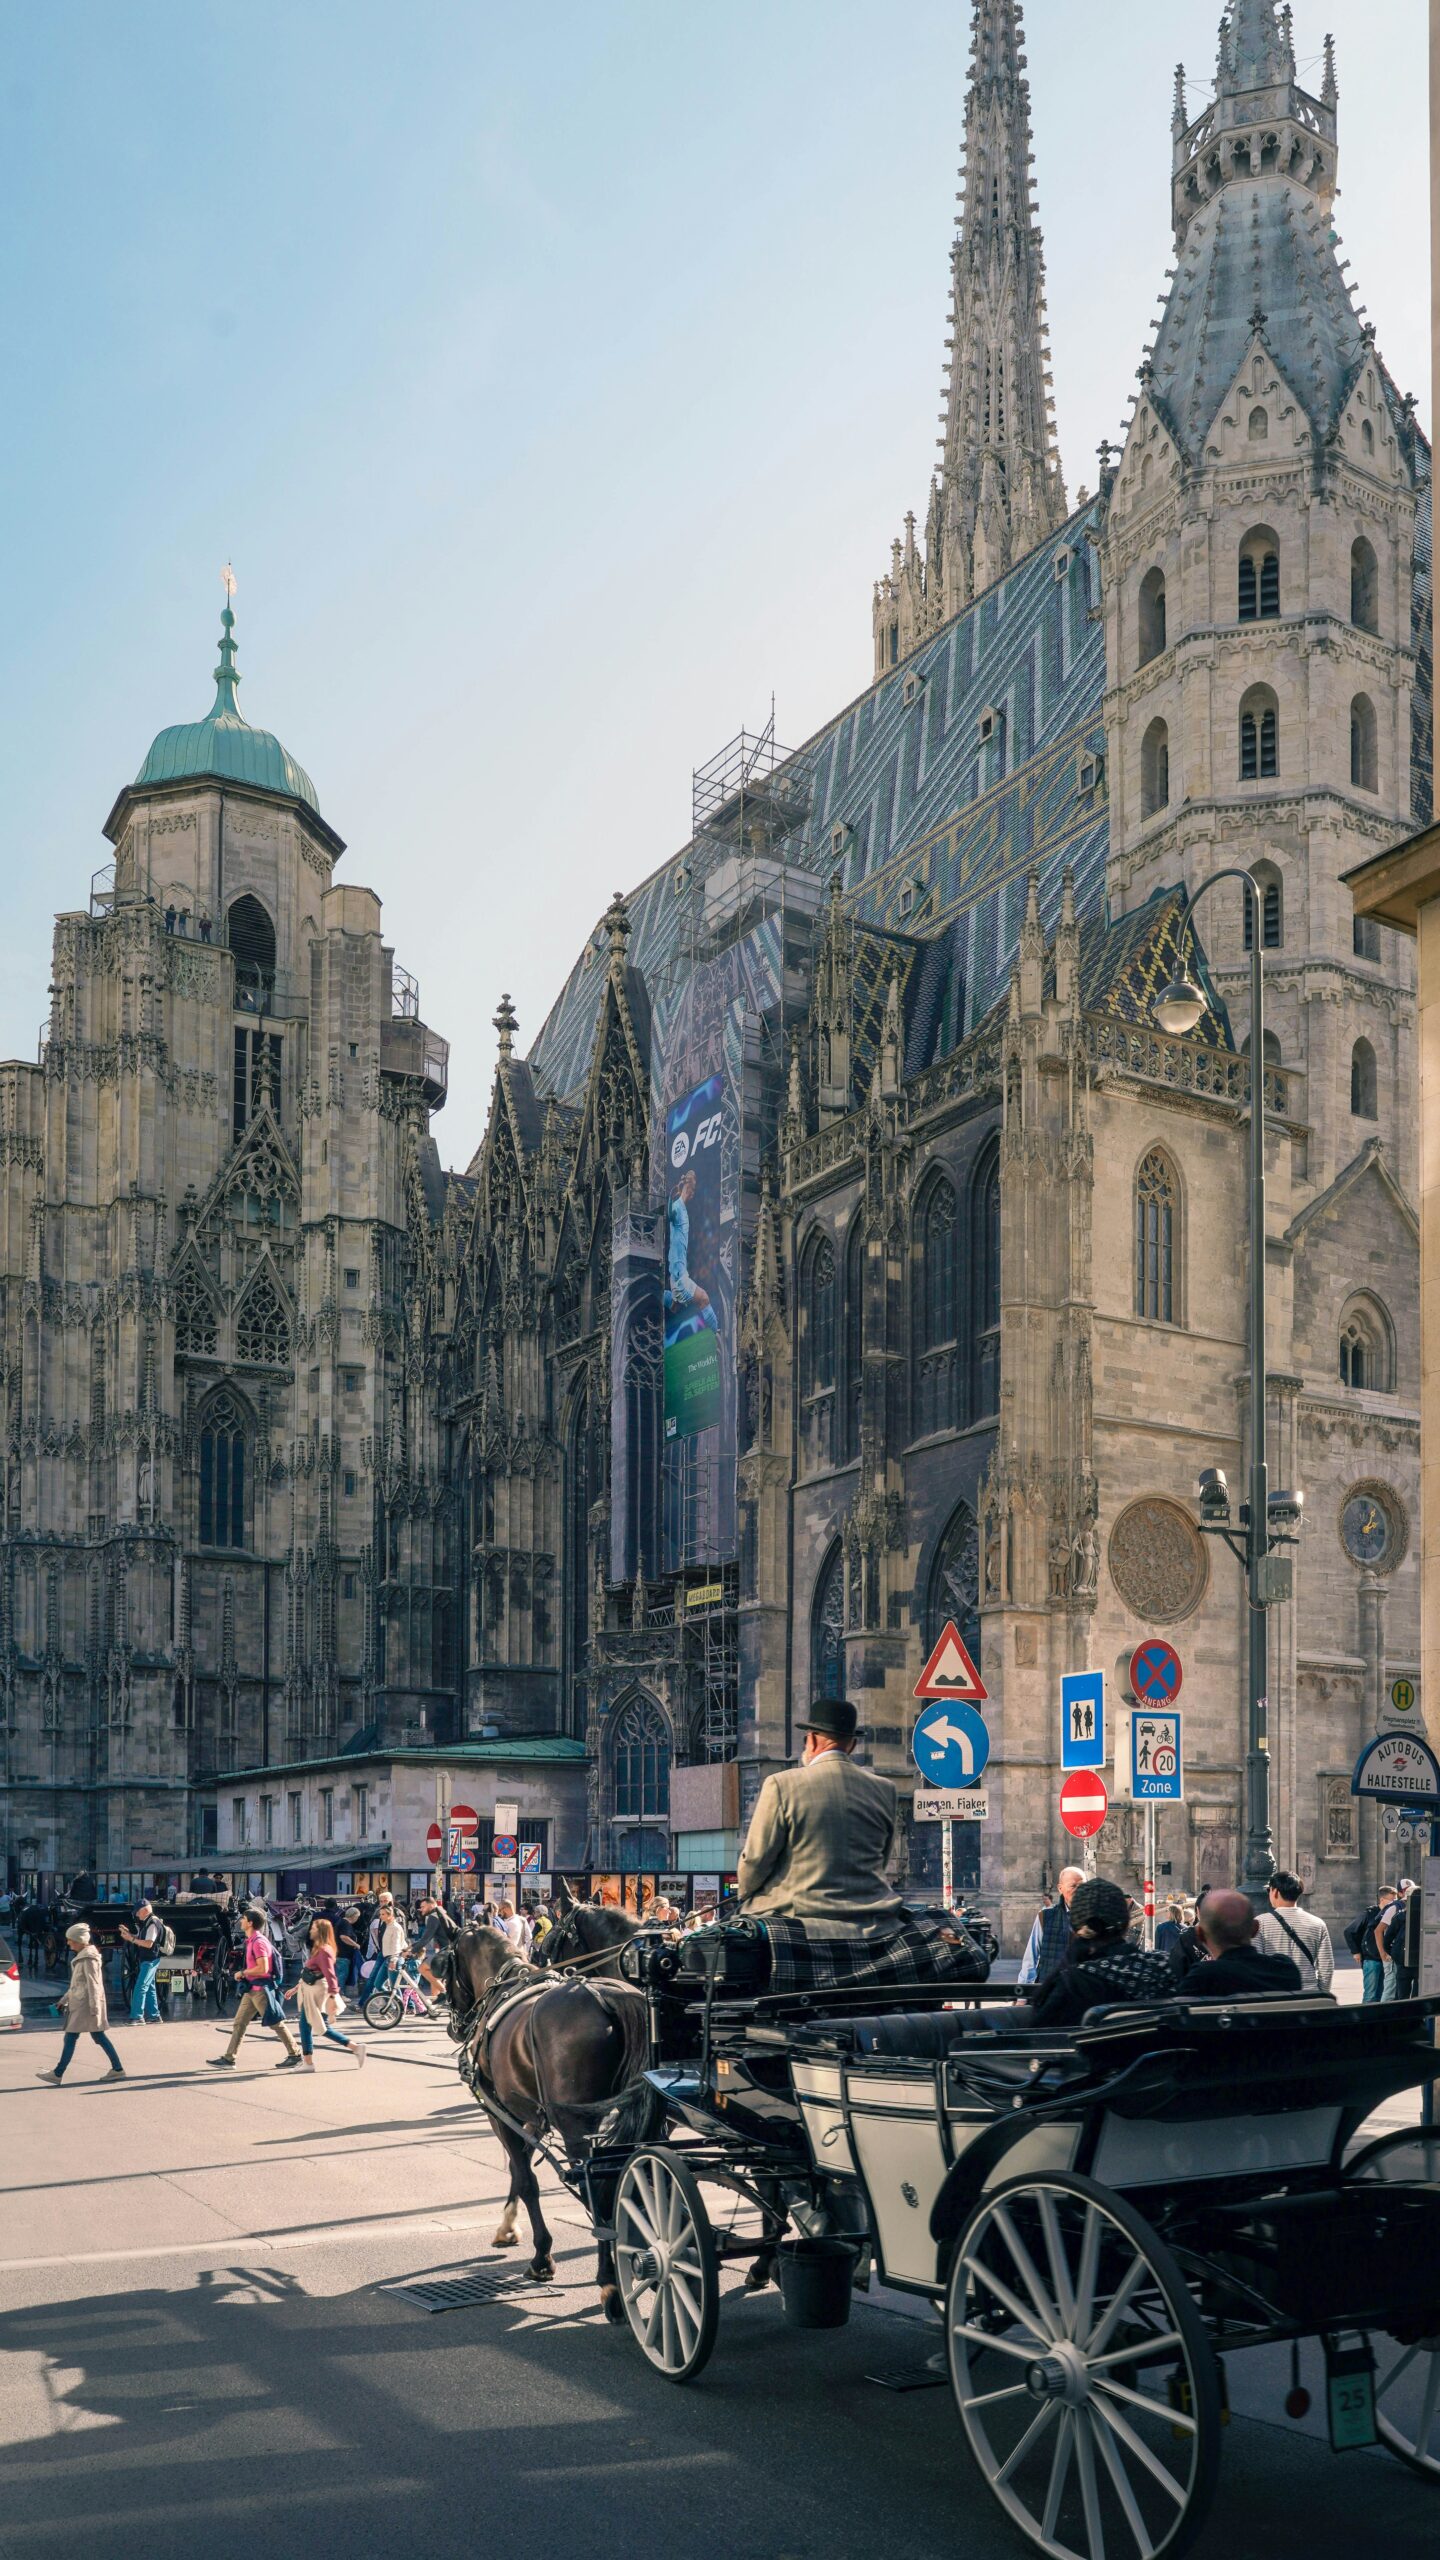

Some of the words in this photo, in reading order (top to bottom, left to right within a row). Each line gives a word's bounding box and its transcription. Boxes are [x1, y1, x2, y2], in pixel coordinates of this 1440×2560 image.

[674, 1140, 686, 1154] EA
[1397, 1684, 1409, 1704] H
[1142, 1695, 1171, 1708] ANFANG
[1378, 1741, 1424, 1766] AUTOBUS
[1159, 1755, 1174, 1771] 20
[1141, 1779, 1172, 1794] Zone
[1367, 1773, 1431, 1791] HALTESTELLE
[917, 1800, 954, 1810] auen.
[957, 1797, 986, 1809] Fiaker
[1387, 1814, 1395, 1824] 1A
[1400, 1828, 1410, 1838] 2A
[1418, 1828, 1427, 1838] 3A
[1339, 2389, 1365, 2411] 25
